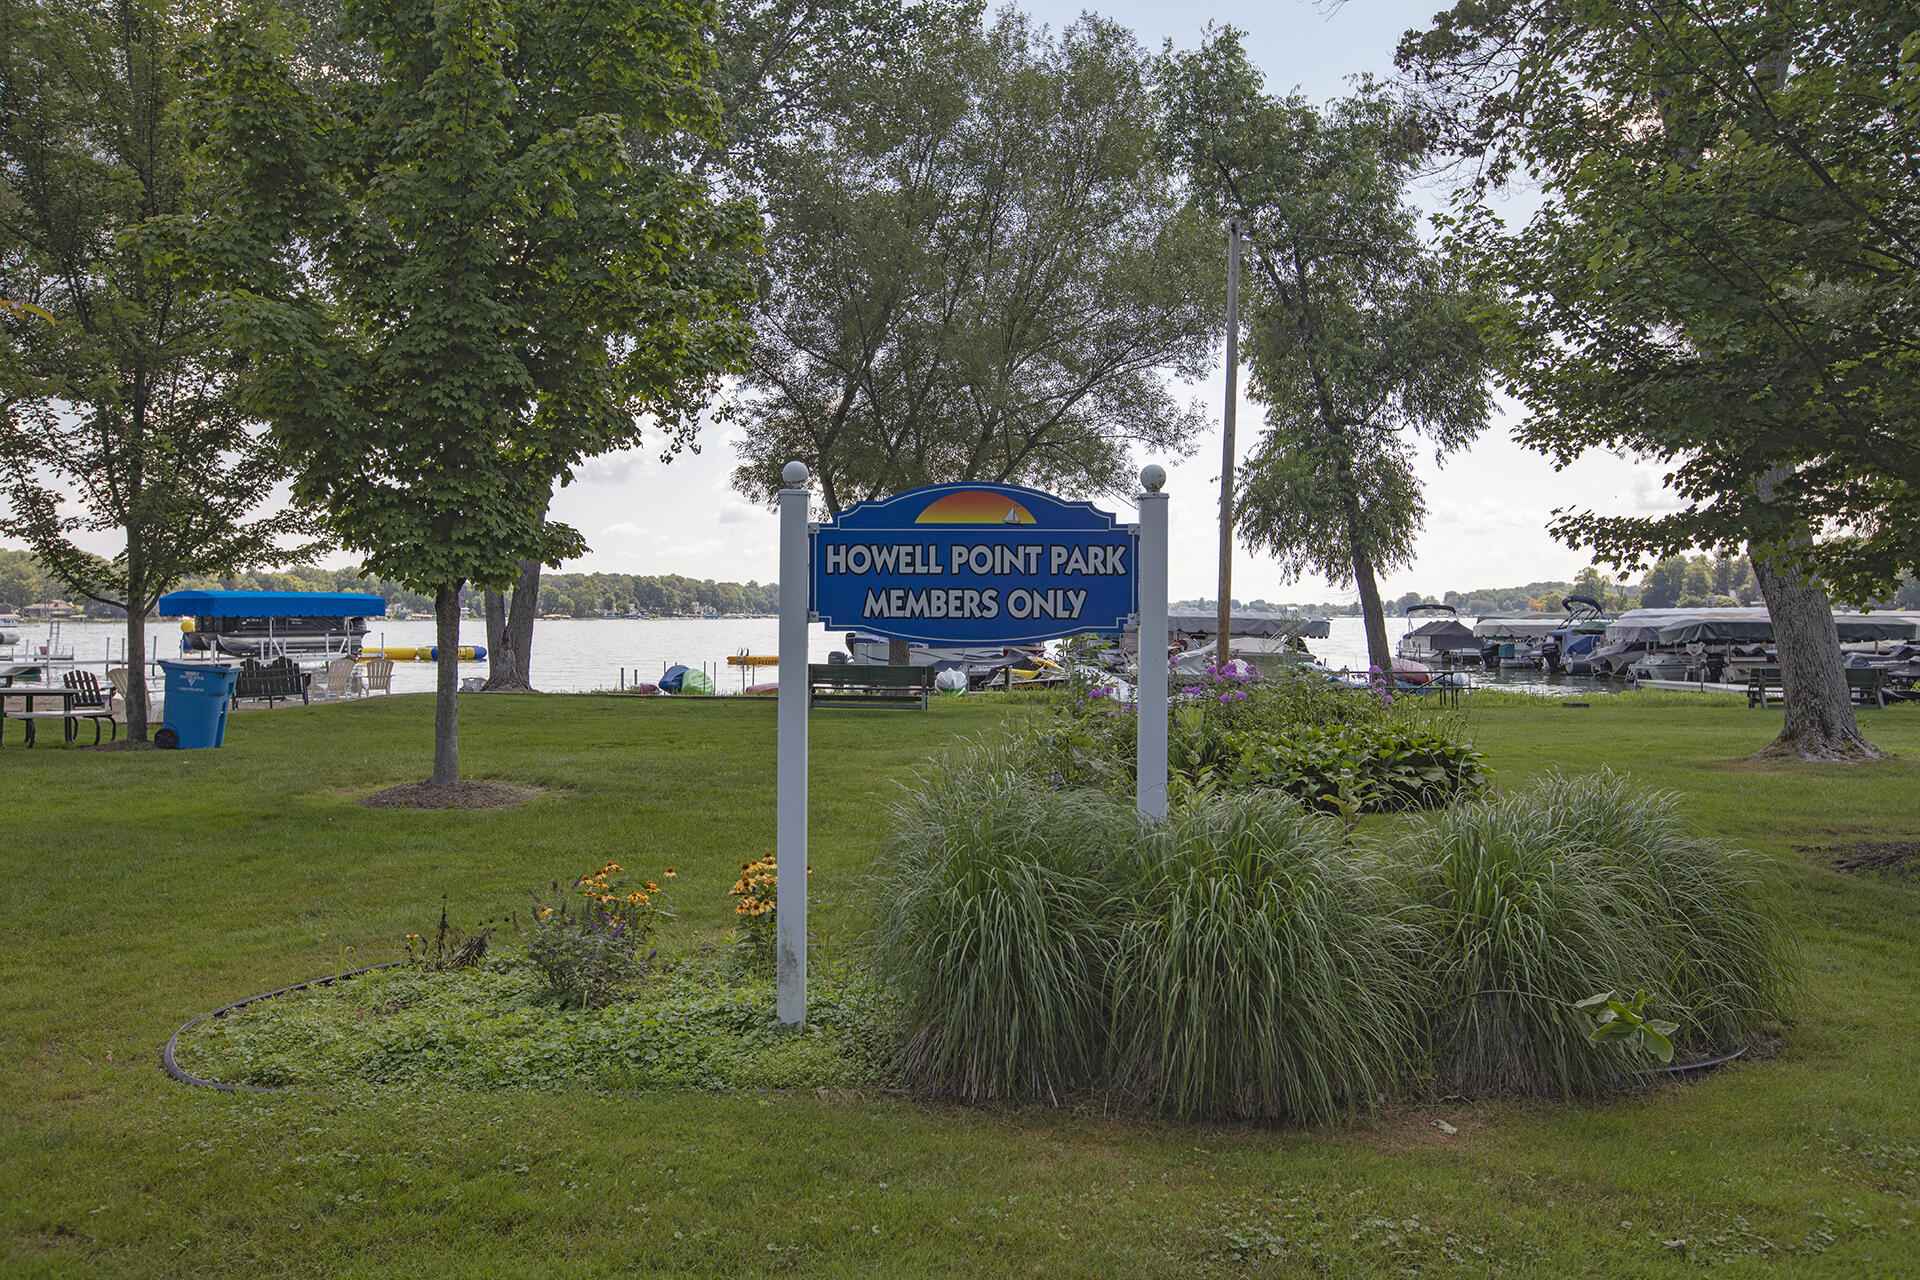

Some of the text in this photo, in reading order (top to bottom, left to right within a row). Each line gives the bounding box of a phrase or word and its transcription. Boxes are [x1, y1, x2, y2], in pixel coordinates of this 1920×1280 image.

[825, 544, 1127, 575] HOWELL POINT PARK
[862, 587, 1087, 619] MEMBERS ONLY
